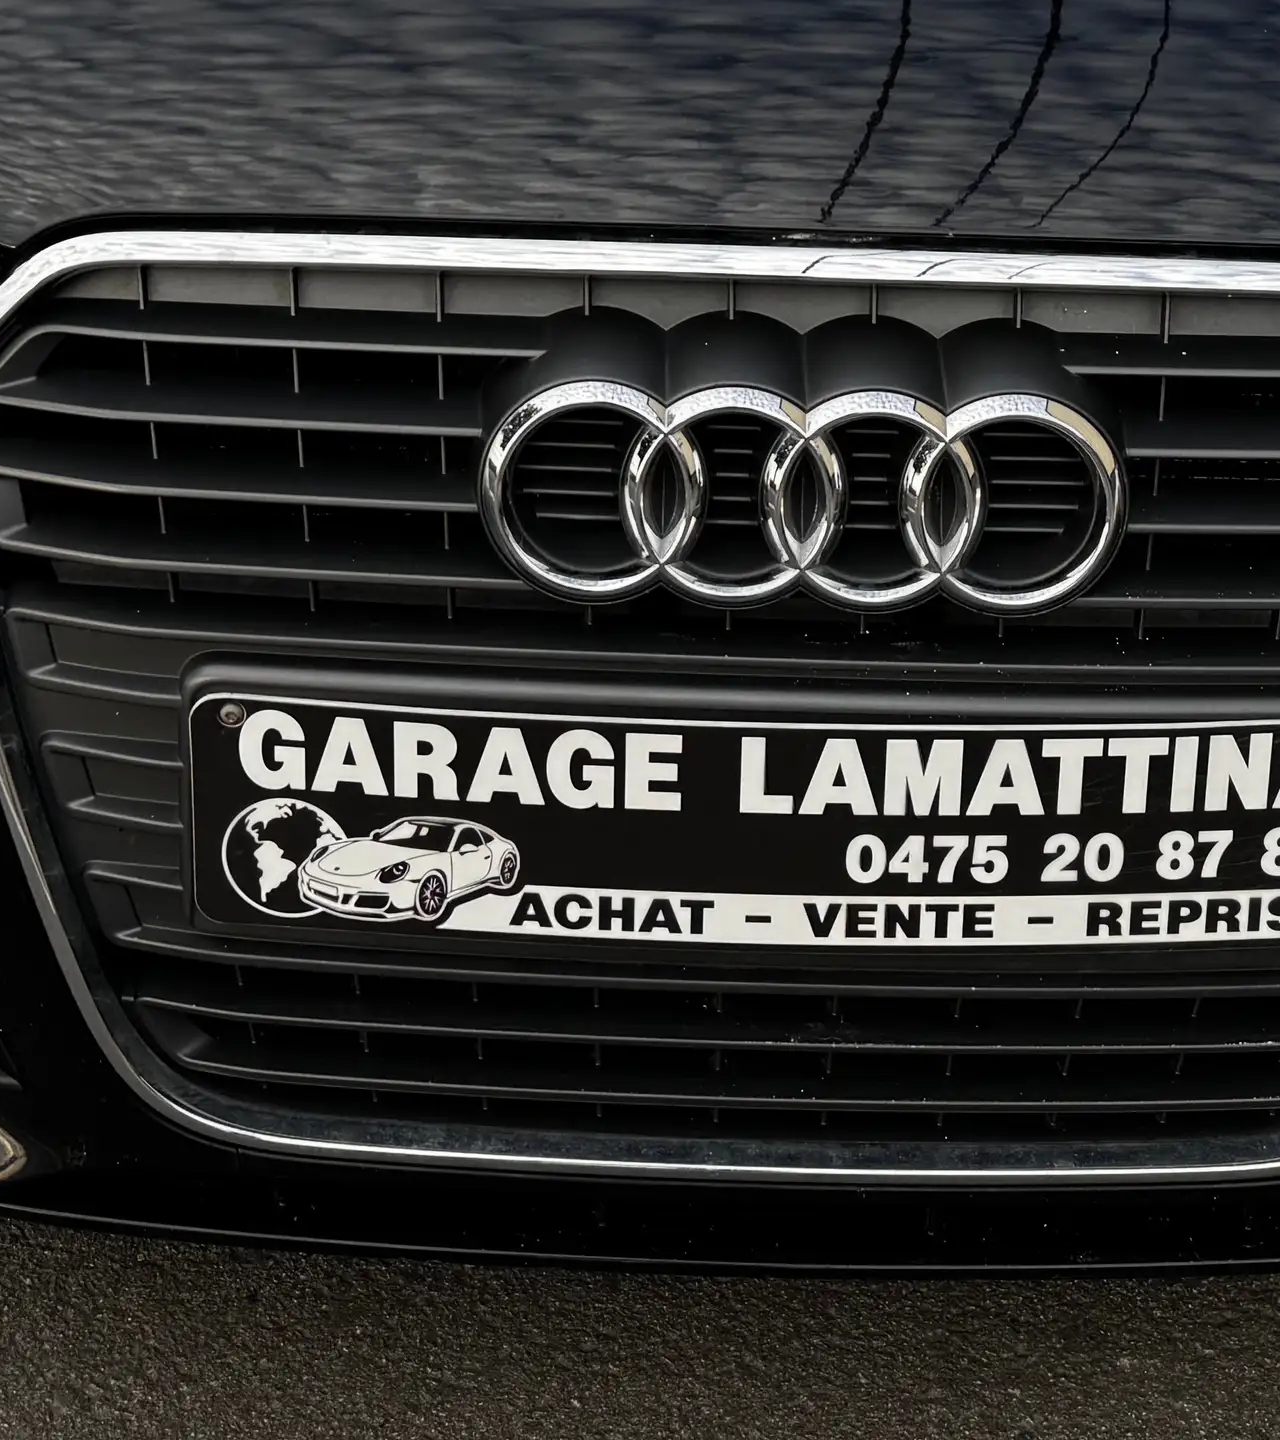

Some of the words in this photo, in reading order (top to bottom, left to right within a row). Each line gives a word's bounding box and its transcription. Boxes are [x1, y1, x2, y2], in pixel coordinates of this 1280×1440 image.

[238, 709, 683, 812] GARAGE
[845, 834, 1009, 884] 0475
[1040, 832, 1125, 882] 20
[1155, 829, 1234, 881] 87
[509, 892, 715, 935] ACHAT
[802, 902, 995, 939] VENTE
